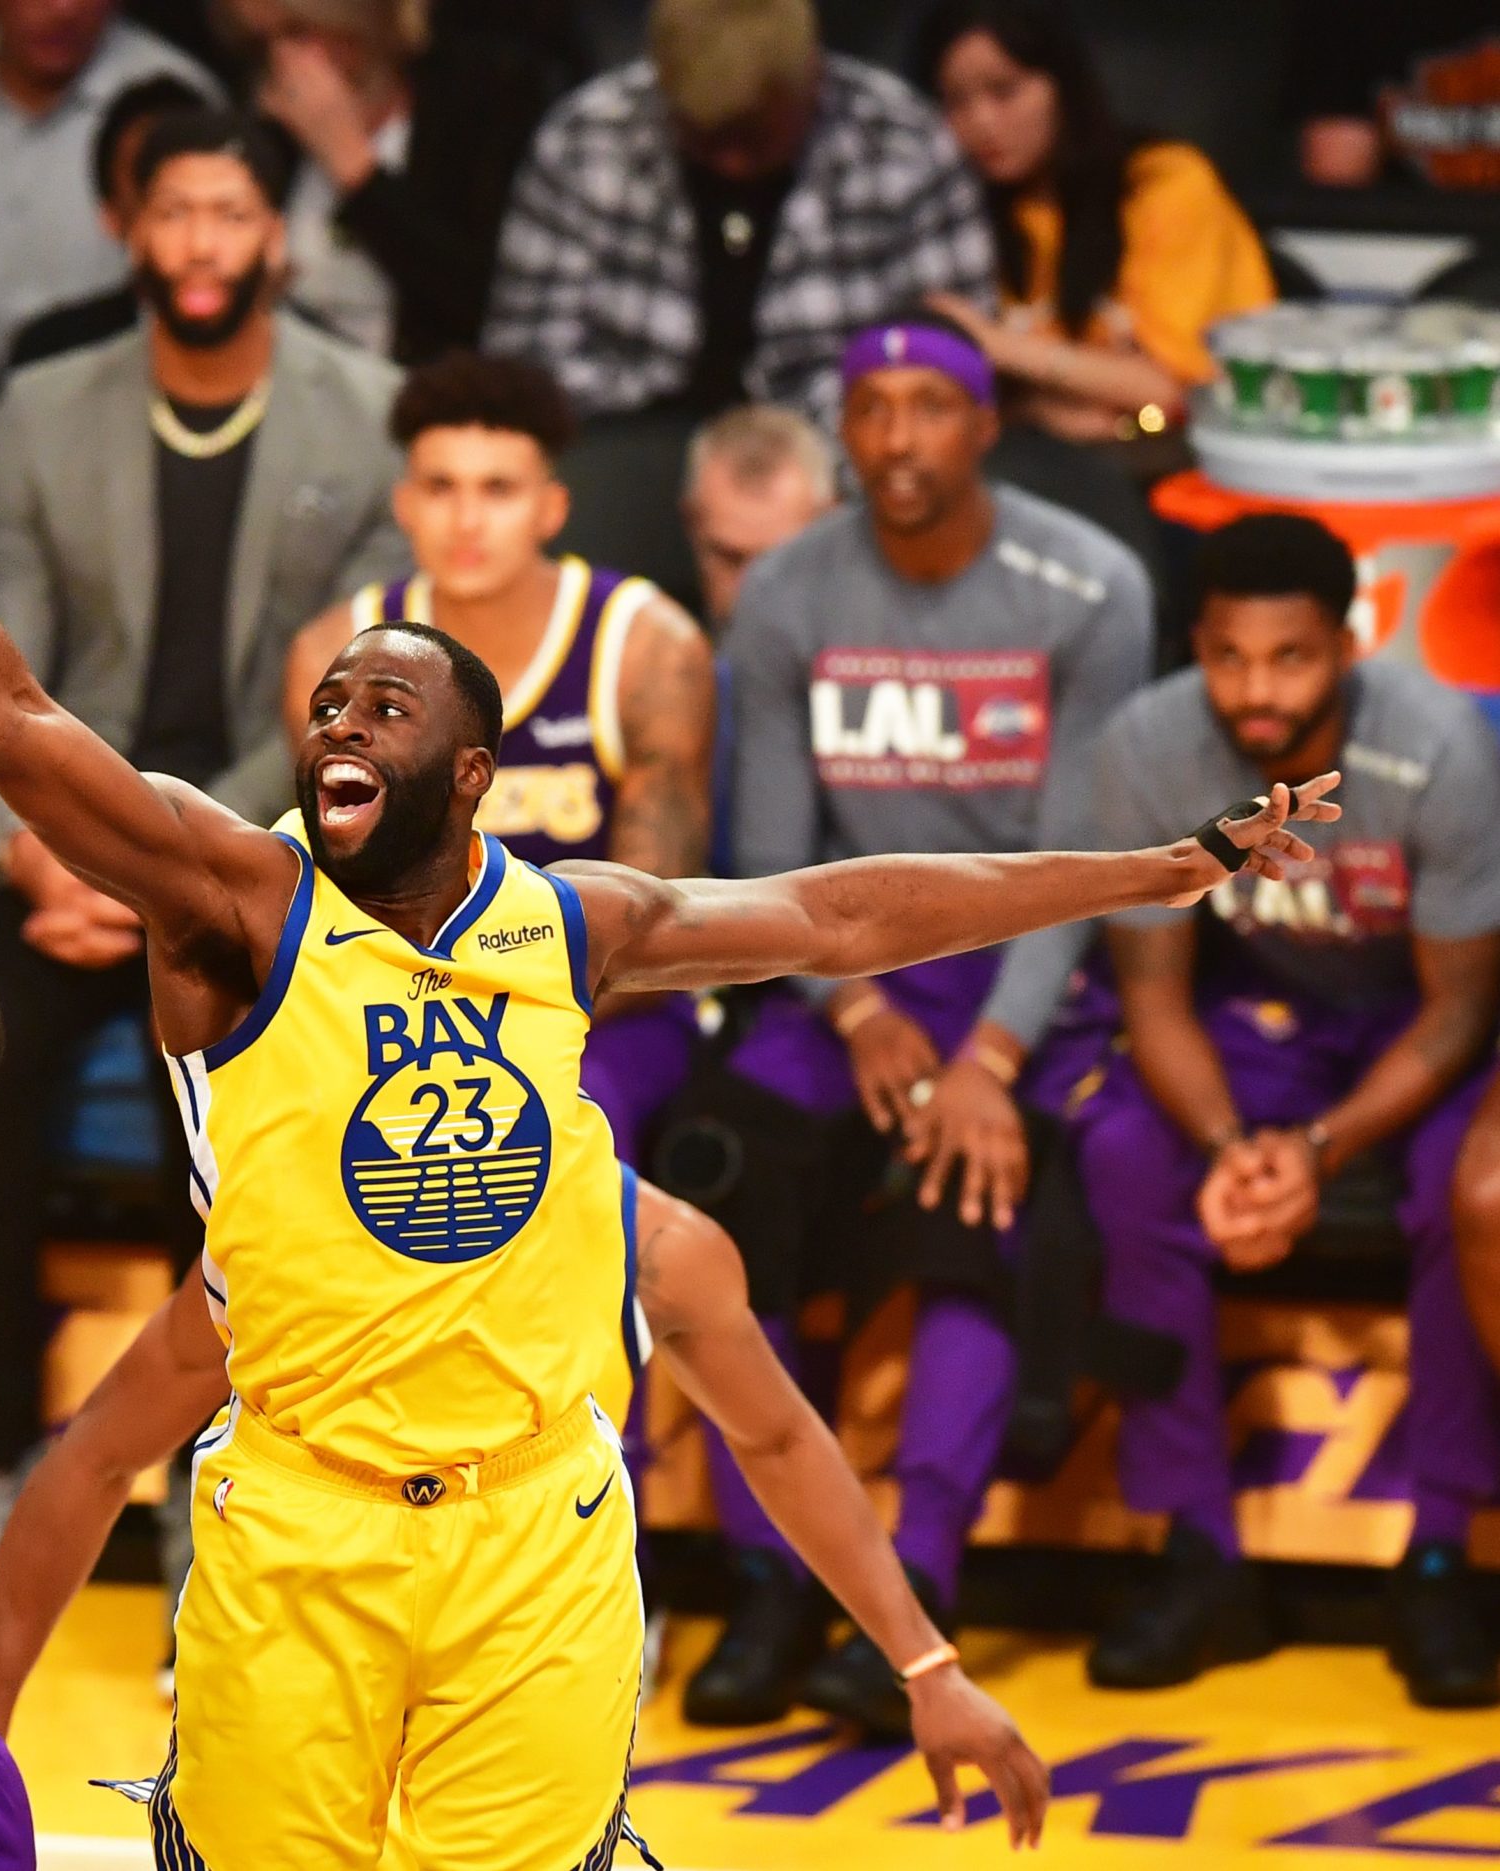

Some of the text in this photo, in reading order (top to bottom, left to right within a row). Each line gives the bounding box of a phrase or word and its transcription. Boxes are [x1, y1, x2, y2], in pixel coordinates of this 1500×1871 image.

[478, 924, 554, 954] Rakuten
[407, 967, 453, 1001] The
[364, 991, 510, 1076] BAY
[409, 1077, 494, 1157] 23
